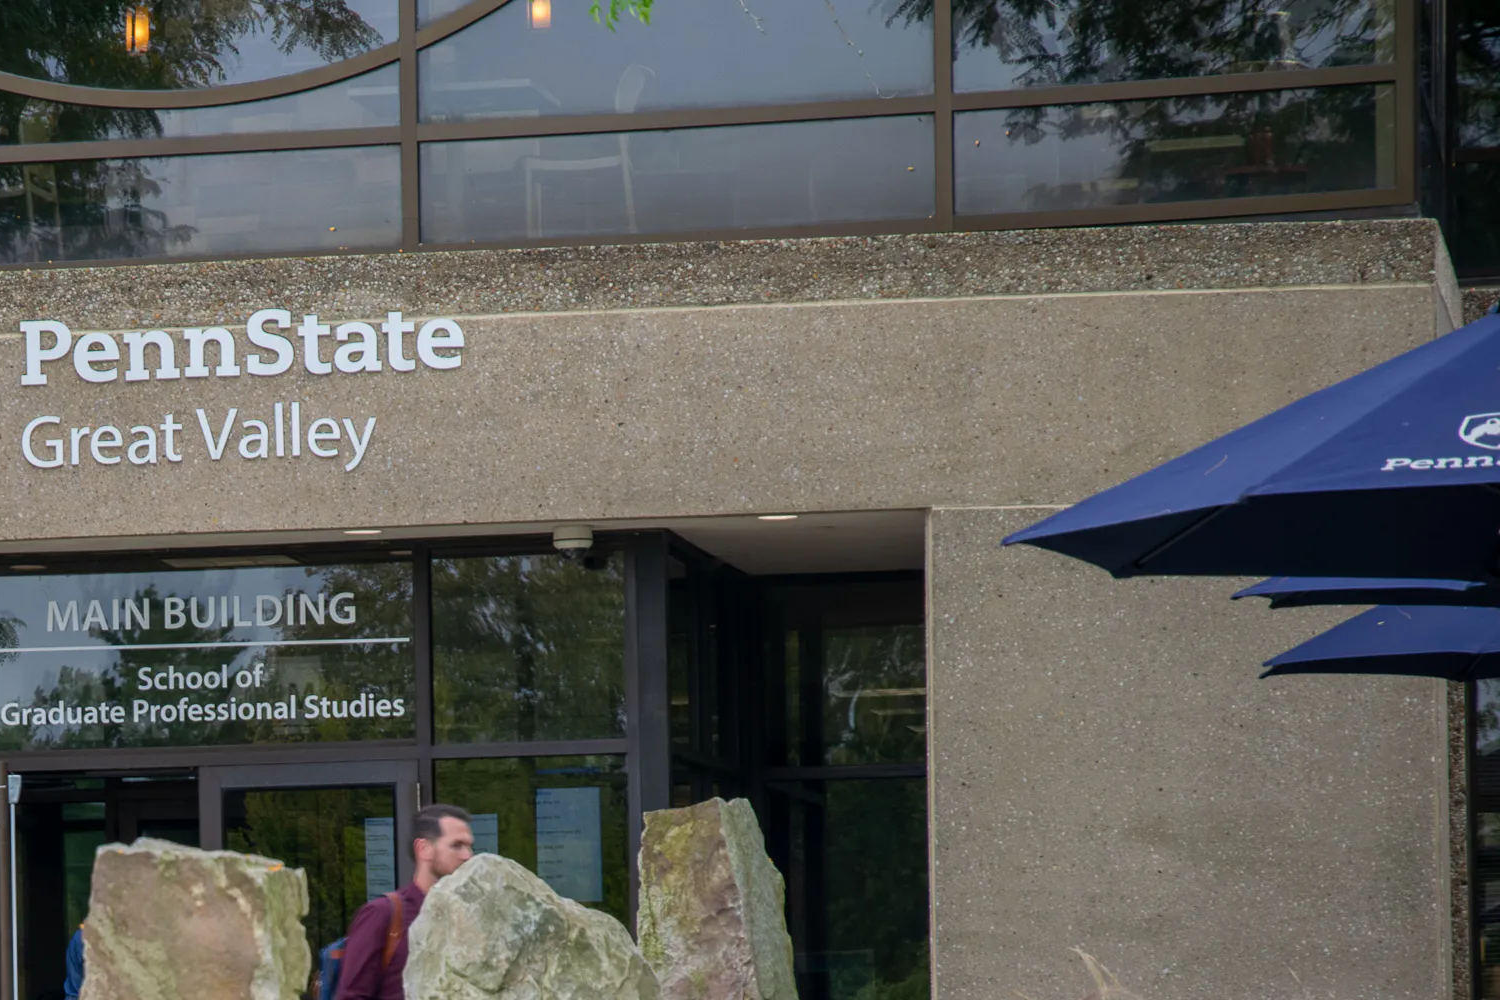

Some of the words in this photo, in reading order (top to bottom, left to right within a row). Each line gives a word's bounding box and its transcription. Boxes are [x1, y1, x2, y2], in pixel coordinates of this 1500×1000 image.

[19, 308, 466, 386] PennState
[21, 413, 184, 469] Great
[194, 401, 378, 472] Valley
[1380, 455, 1500, 471] Penn
[46, 599, 150, 632] MAIN
[164, 592, 357, 629] BUILDING
[137, 664, 228, 692] School
[235, 662, 265, 689] of
[0, 700, 126, 726] Graduate
[132, 694, 297, 724] Professional
[303, 692, 406, 719] Studies
